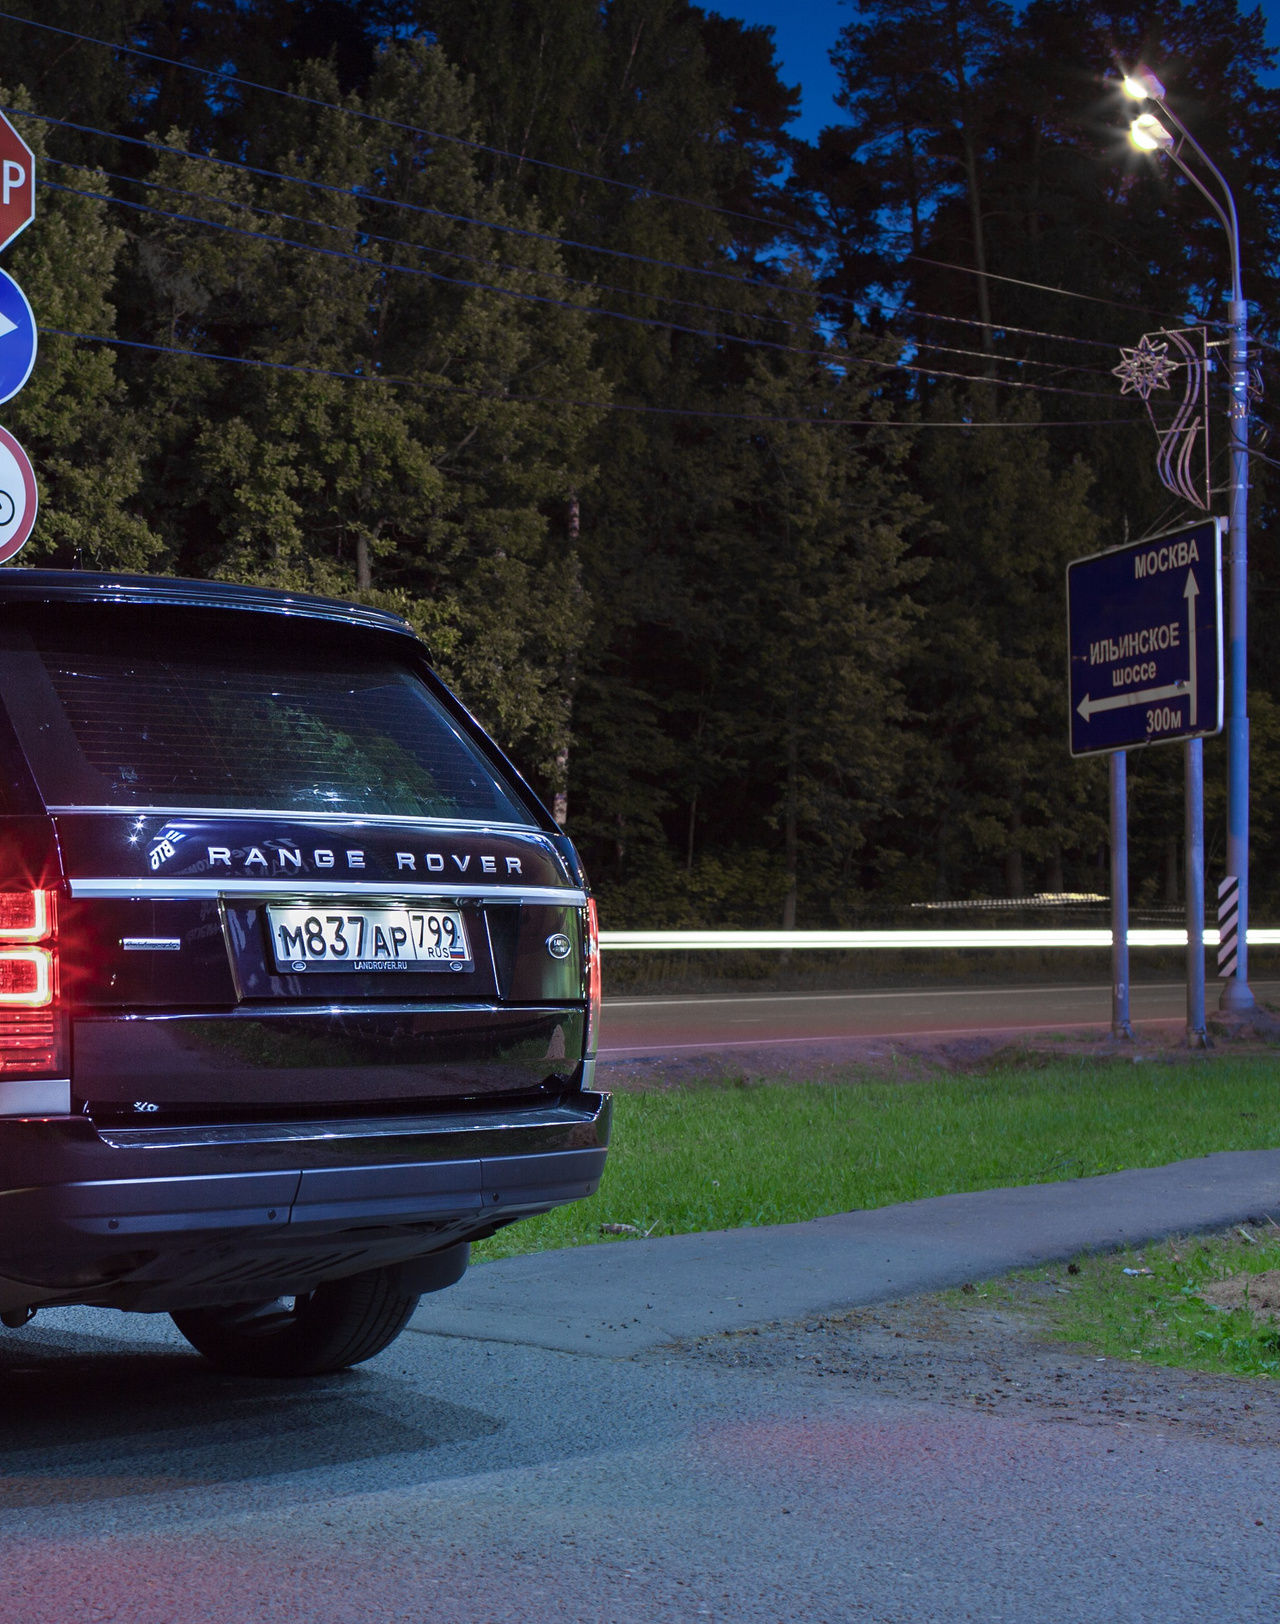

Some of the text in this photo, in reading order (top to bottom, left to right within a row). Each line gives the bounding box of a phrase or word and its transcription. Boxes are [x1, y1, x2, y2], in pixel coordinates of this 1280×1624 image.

[1134, 539, 1200, 579] МОСКВА
[1090, 622, 1180, 665] ИЛЬИНСКОЕ
[1112, 661, 1157, 687] шоссе
[1146, 706, 1182, 733] 300м
[207, 846, 366, 869] RANGE
[395, 852, 523, 874] ROVER
[412, 915, 456, 948] 799
[353, 961, 408, 970] LANDROVER.RU
[428, 947, 450, 958] RUS
